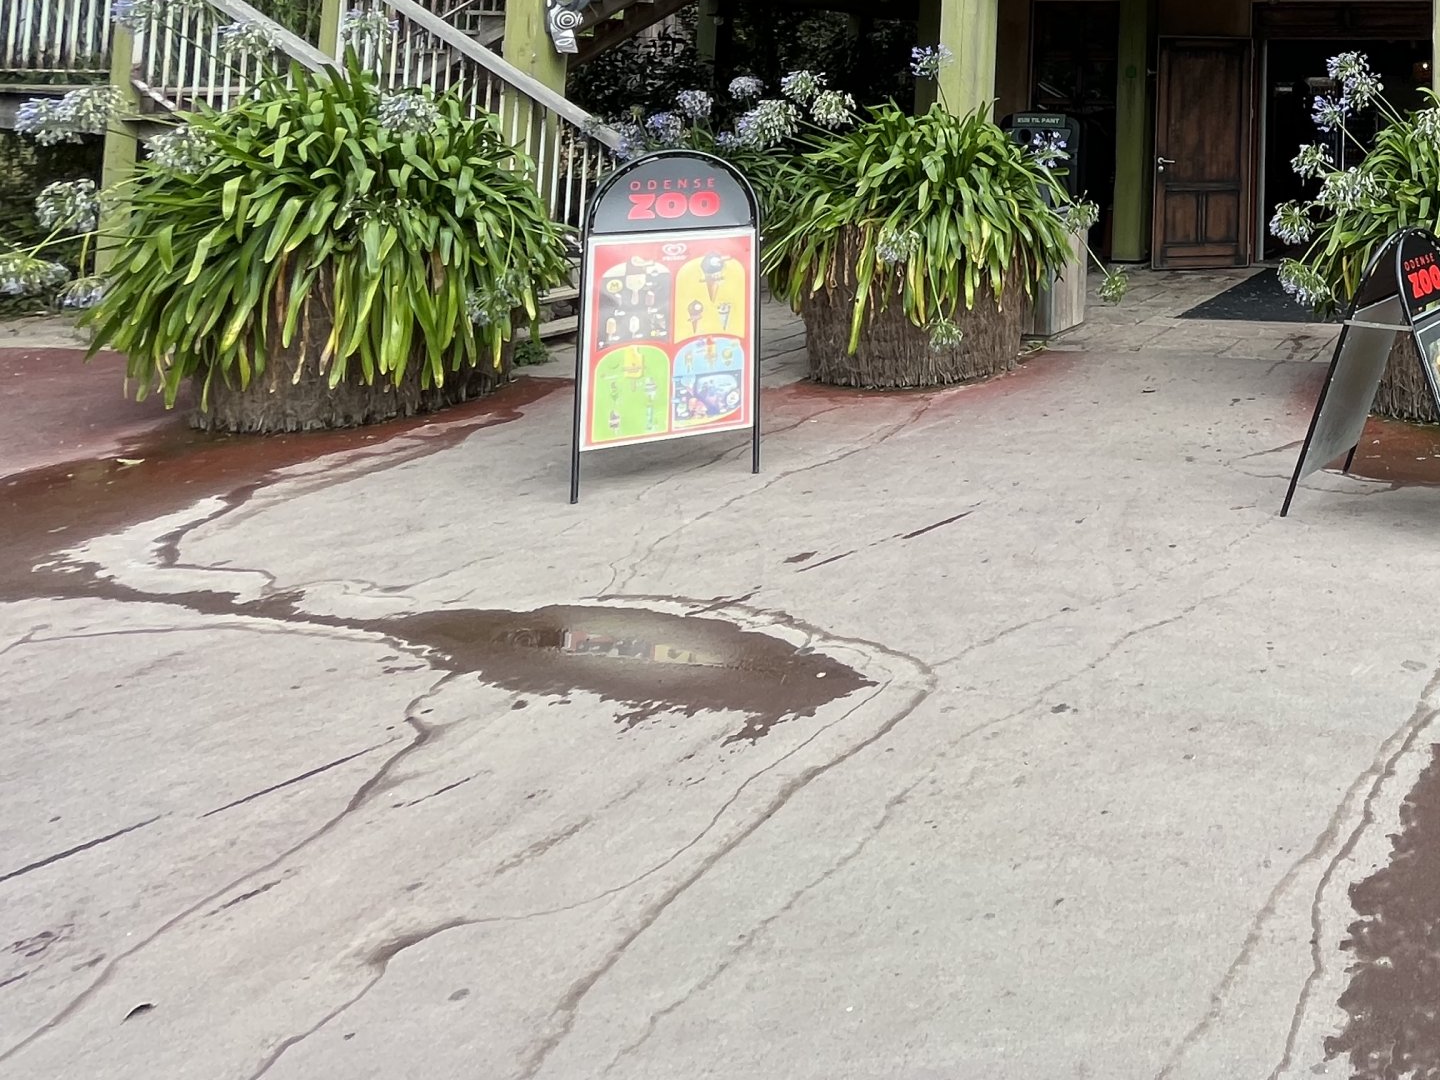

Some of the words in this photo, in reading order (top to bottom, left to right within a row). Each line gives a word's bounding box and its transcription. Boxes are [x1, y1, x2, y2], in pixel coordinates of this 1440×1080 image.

[629, 177, 716, 191] ODENSE
[627, 190, 721, 220] ZOO
[1404, 252, 1436, 272] ODENSE
